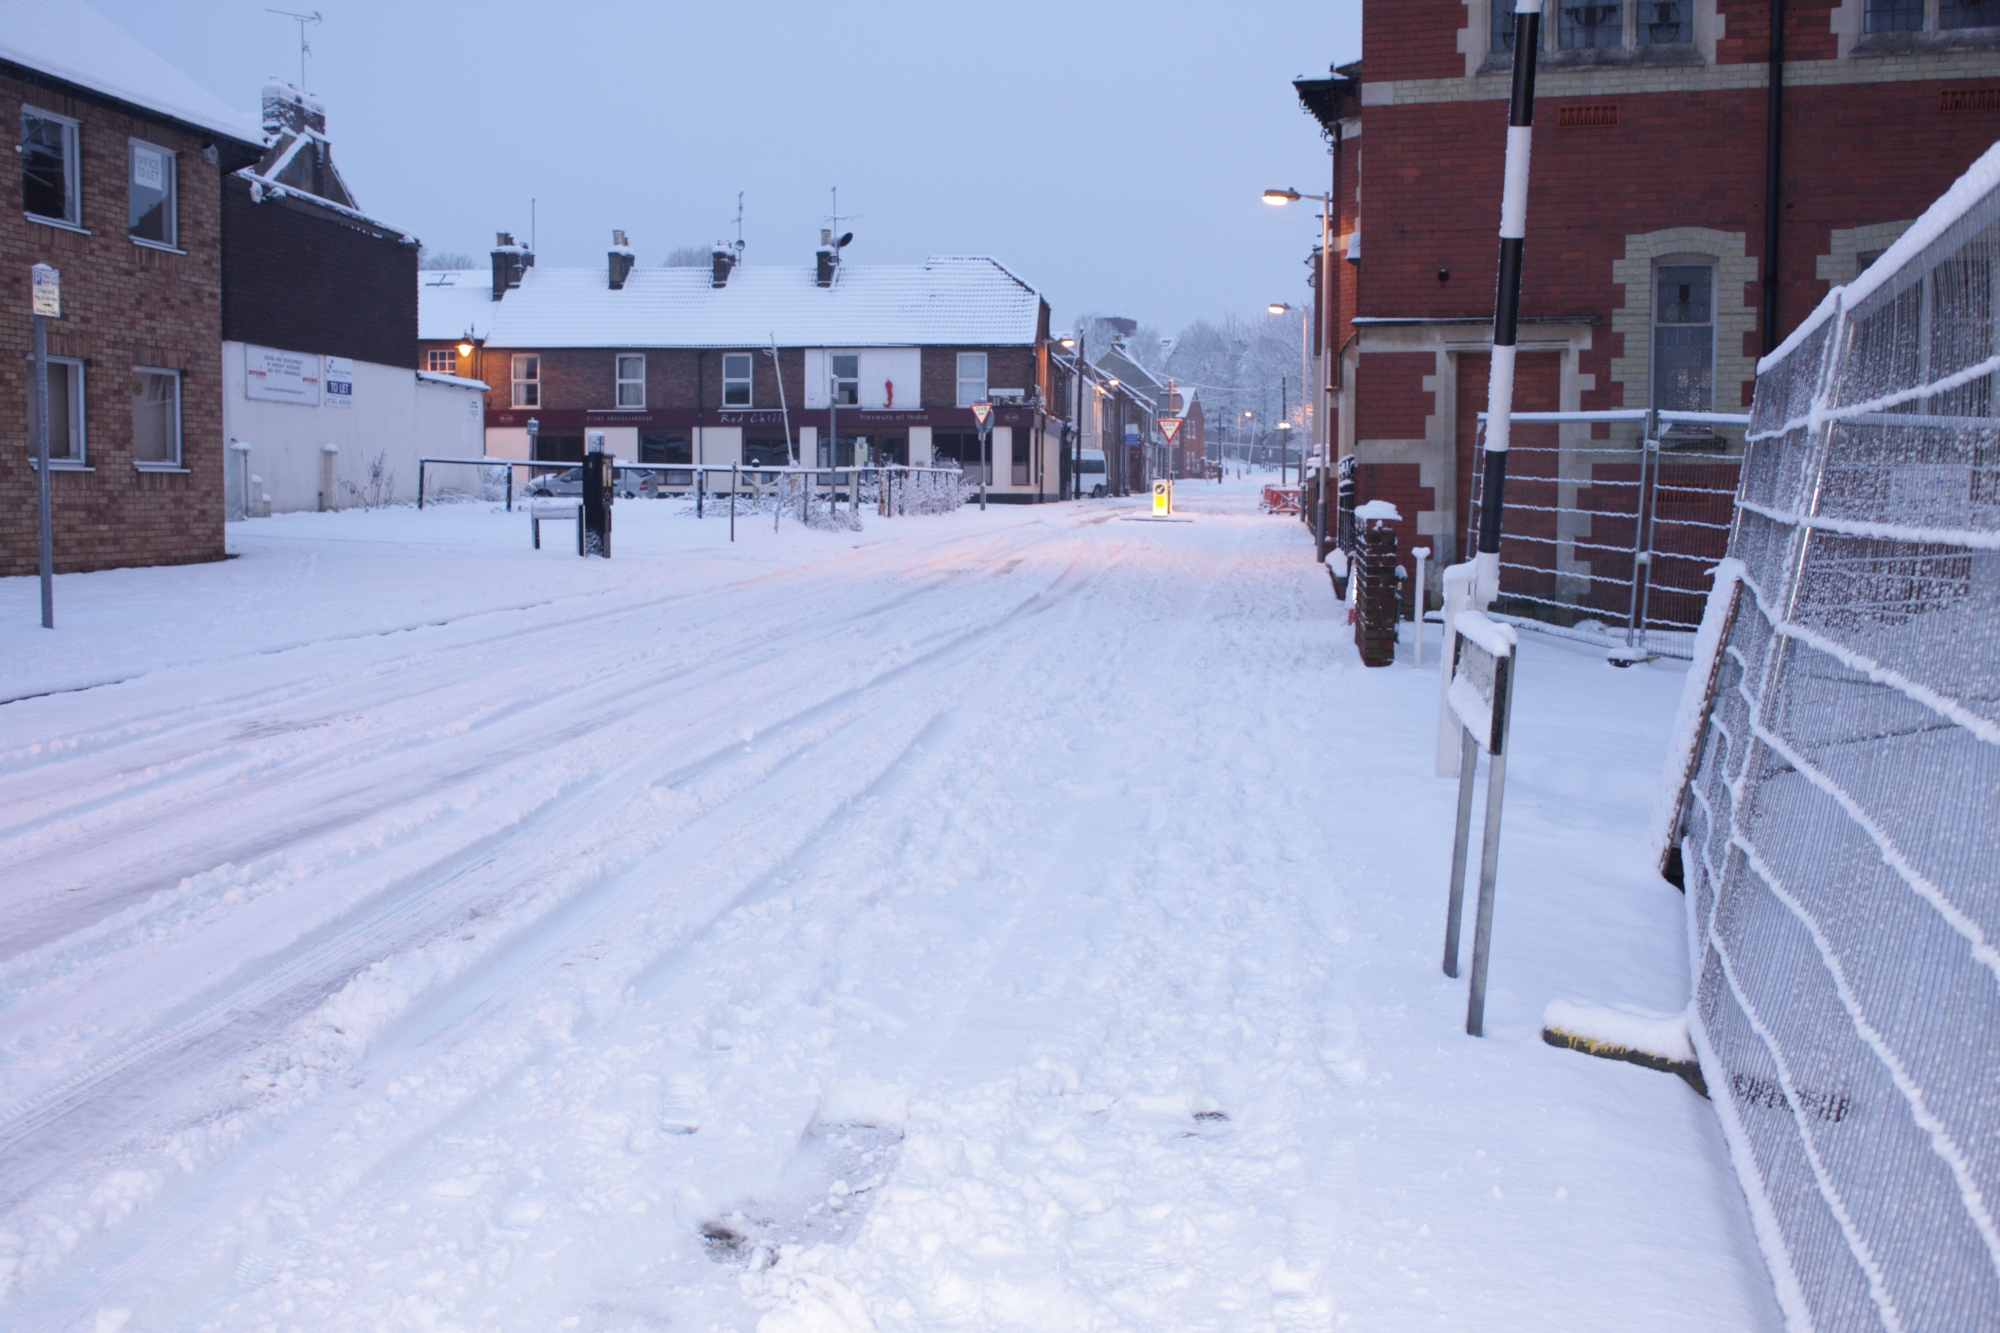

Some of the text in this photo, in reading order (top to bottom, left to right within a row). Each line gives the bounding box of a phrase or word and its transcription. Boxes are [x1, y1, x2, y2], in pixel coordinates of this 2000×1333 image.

[136, 154, 160, 171] OFFICE
[137, 166, 159, 182] TO LET
[330, 382, 349, 394] TO LET
[721, 412, 782, 424] Red Chill
